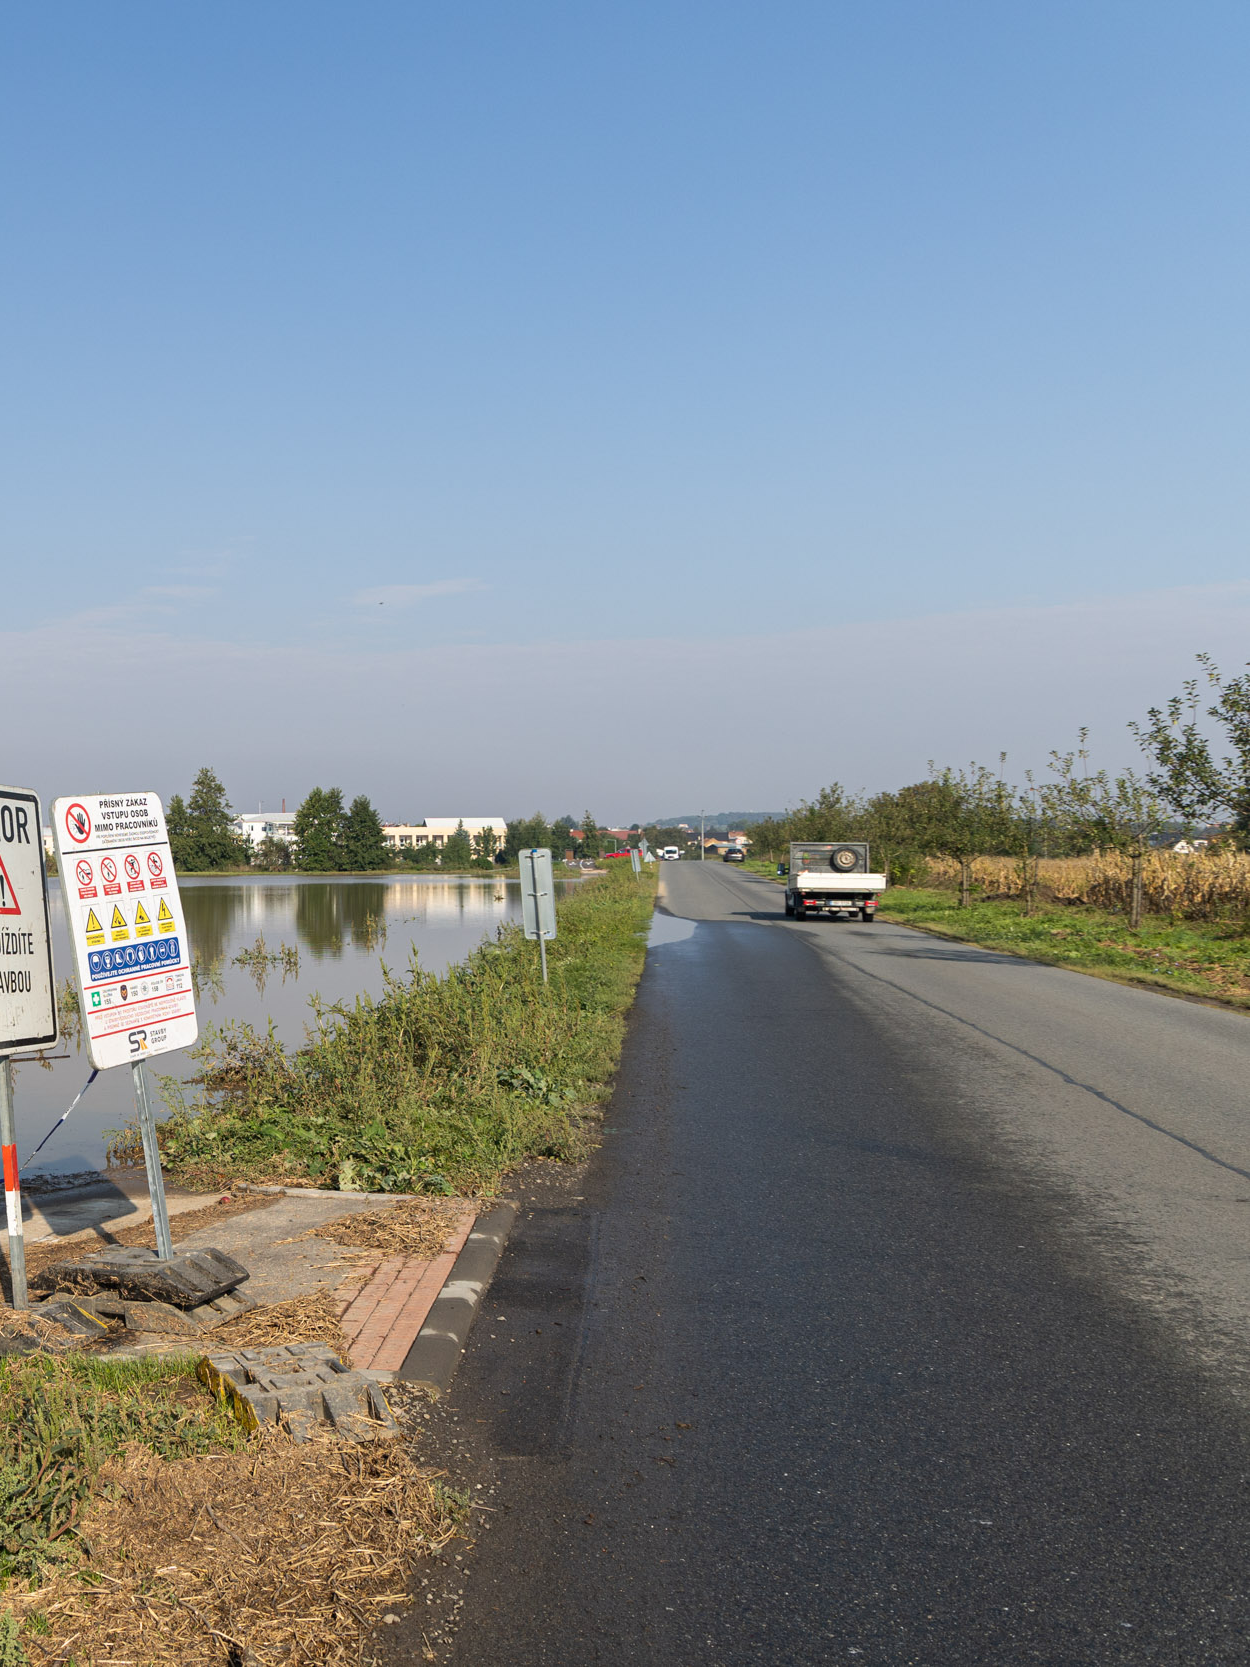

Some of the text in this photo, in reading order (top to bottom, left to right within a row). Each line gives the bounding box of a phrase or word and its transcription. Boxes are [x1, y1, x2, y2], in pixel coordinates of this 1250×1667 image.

[99, 796, 148, 808] PŘÍSNÝ ZÁKAZ
[101, 809, 148, 820] VSTUPU OSOB
[94, 817, 158, 832] MIMO PRACOVNÍKŮ
[150, 1028, 166, 1037] STAVBY
[151, 1034, 167, 1044] GROUP
